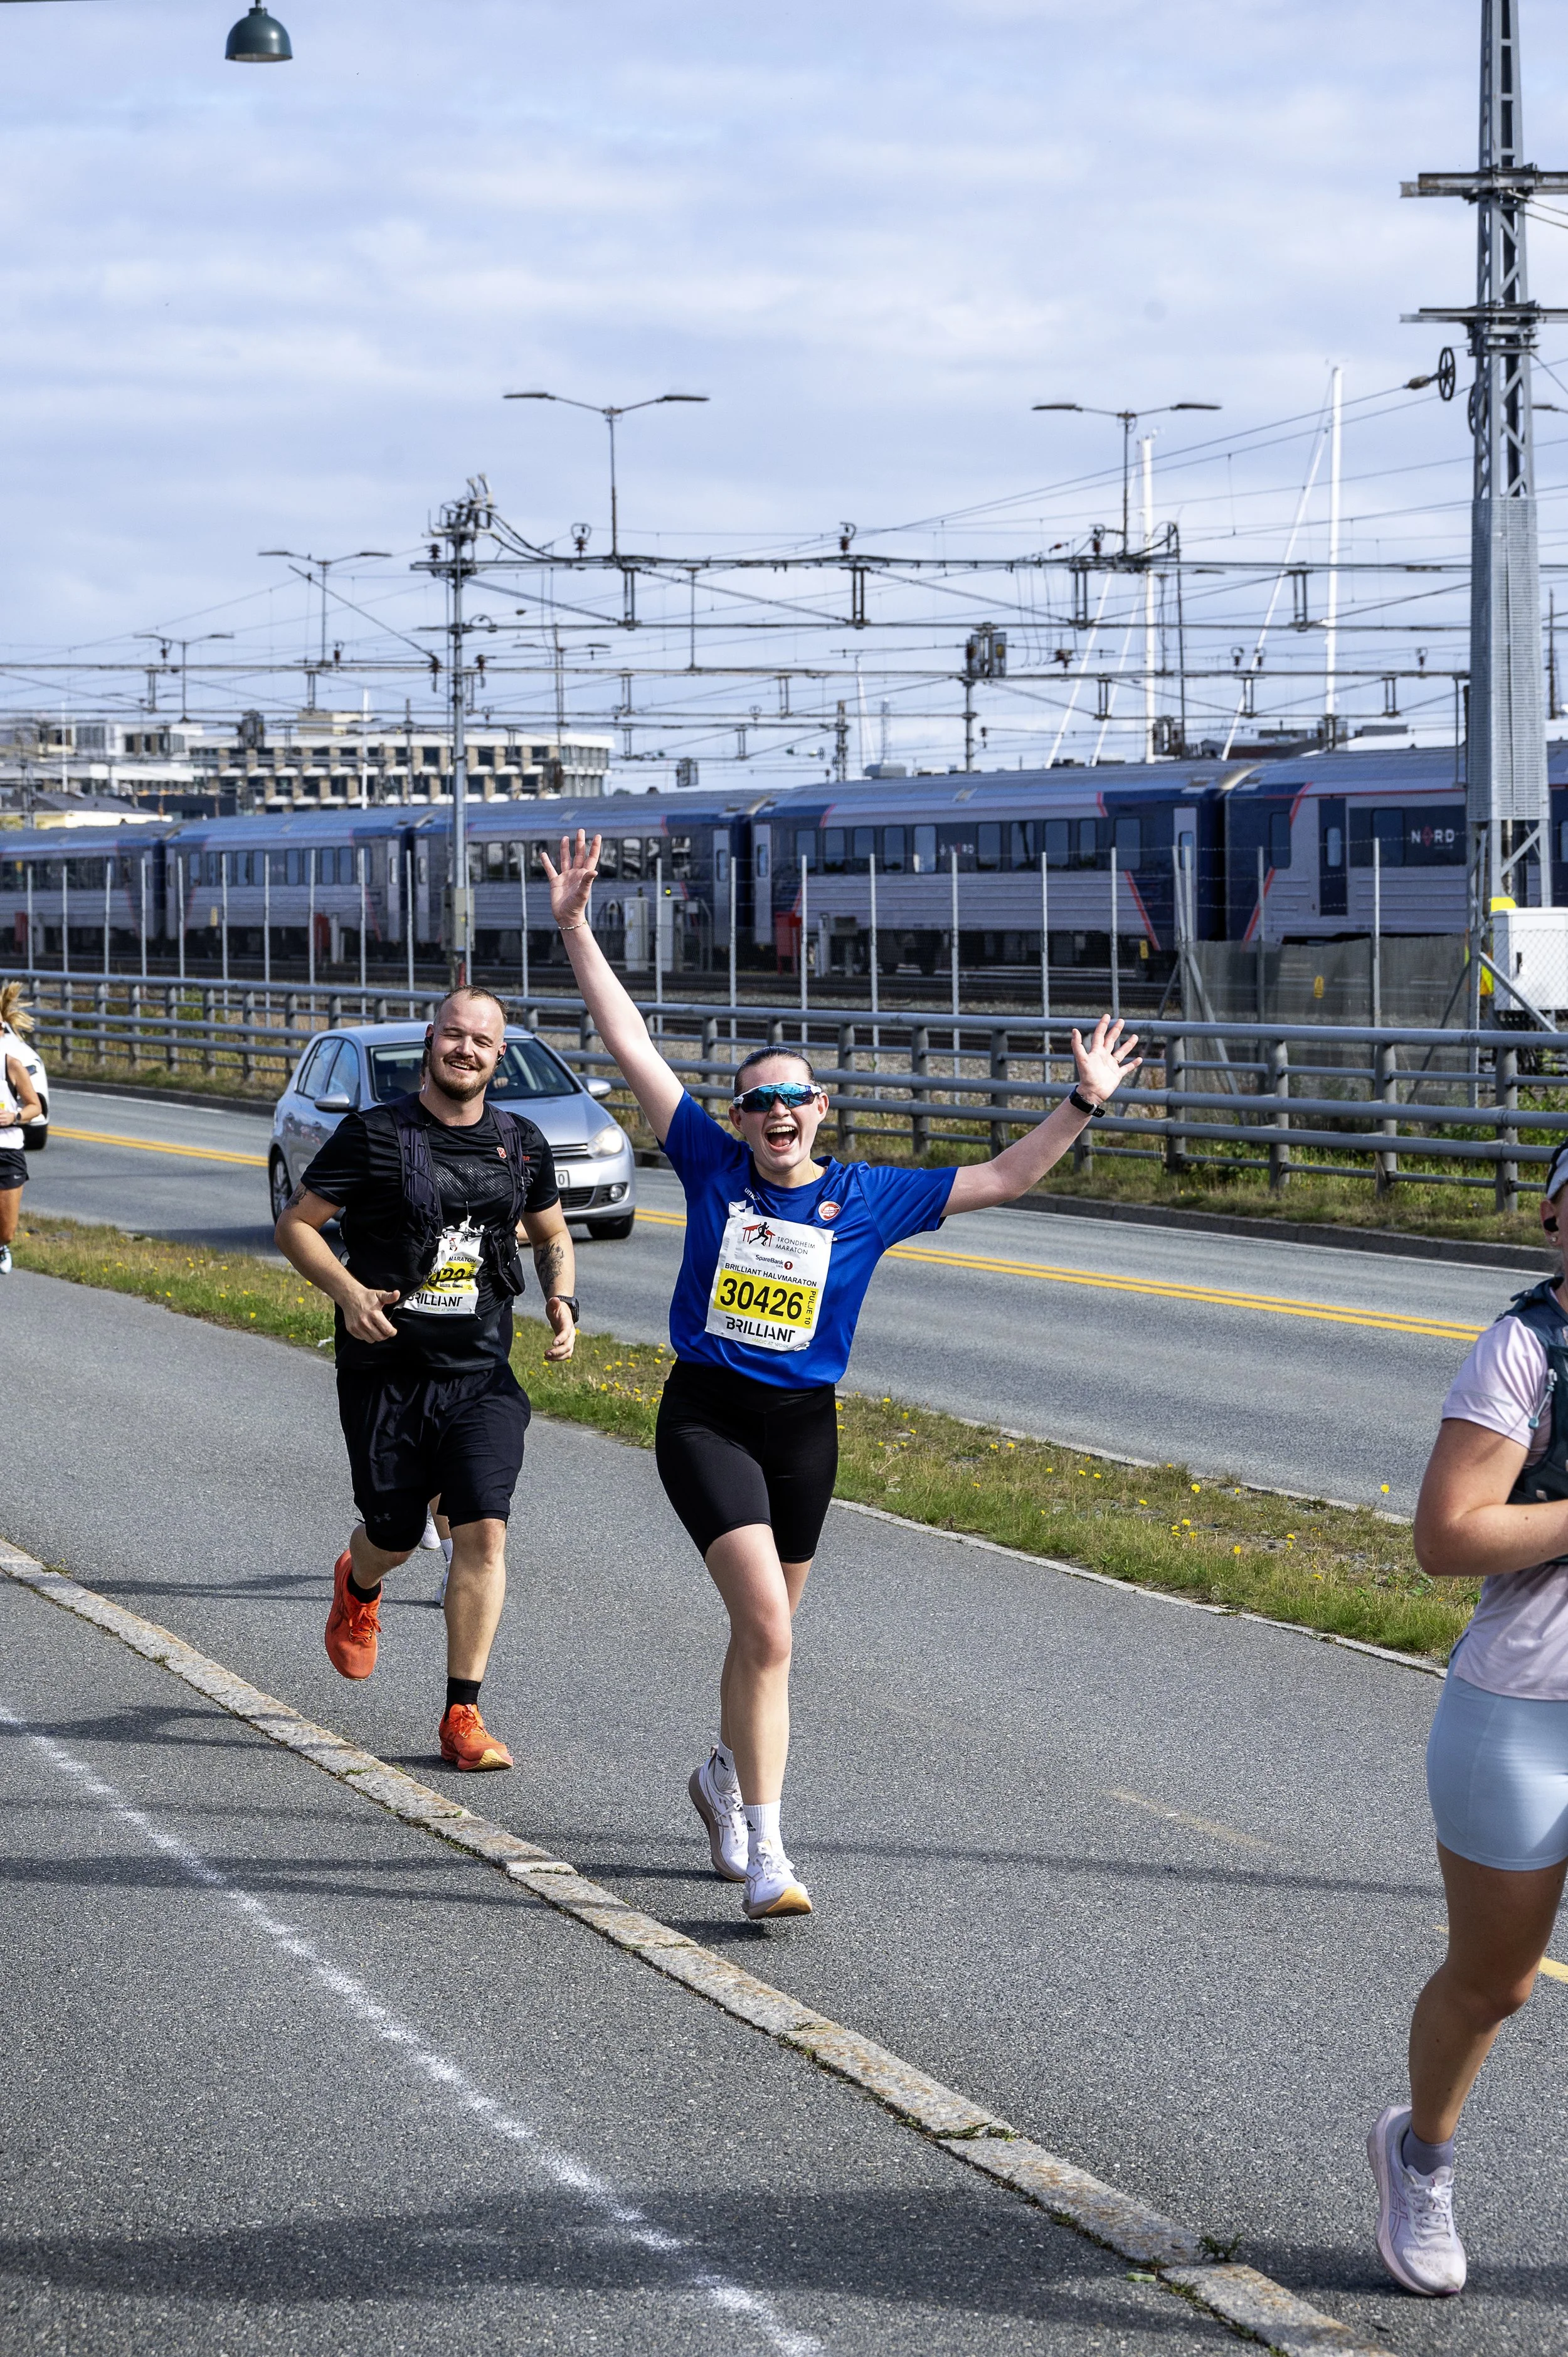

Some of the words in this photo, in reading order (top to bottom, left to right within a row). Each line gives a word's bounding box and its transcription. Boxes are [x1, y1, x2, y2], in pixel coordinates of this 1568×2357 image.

[775, 1244, 808, 1255] MARATON
[777, 1237, 815, 1248] TRONDHEIM
[755, 1255, 783, 1265] SpareBank
[725, 1262, 761, 1275] BRILLIANT
[763, 1270, 817, 1287] HALVMARATON
[720, 1278, 803, 1319] 30426
[806, 1290, 816, 1314] PULJE
[725, 1316, 795, 1343] BRILLIANT
